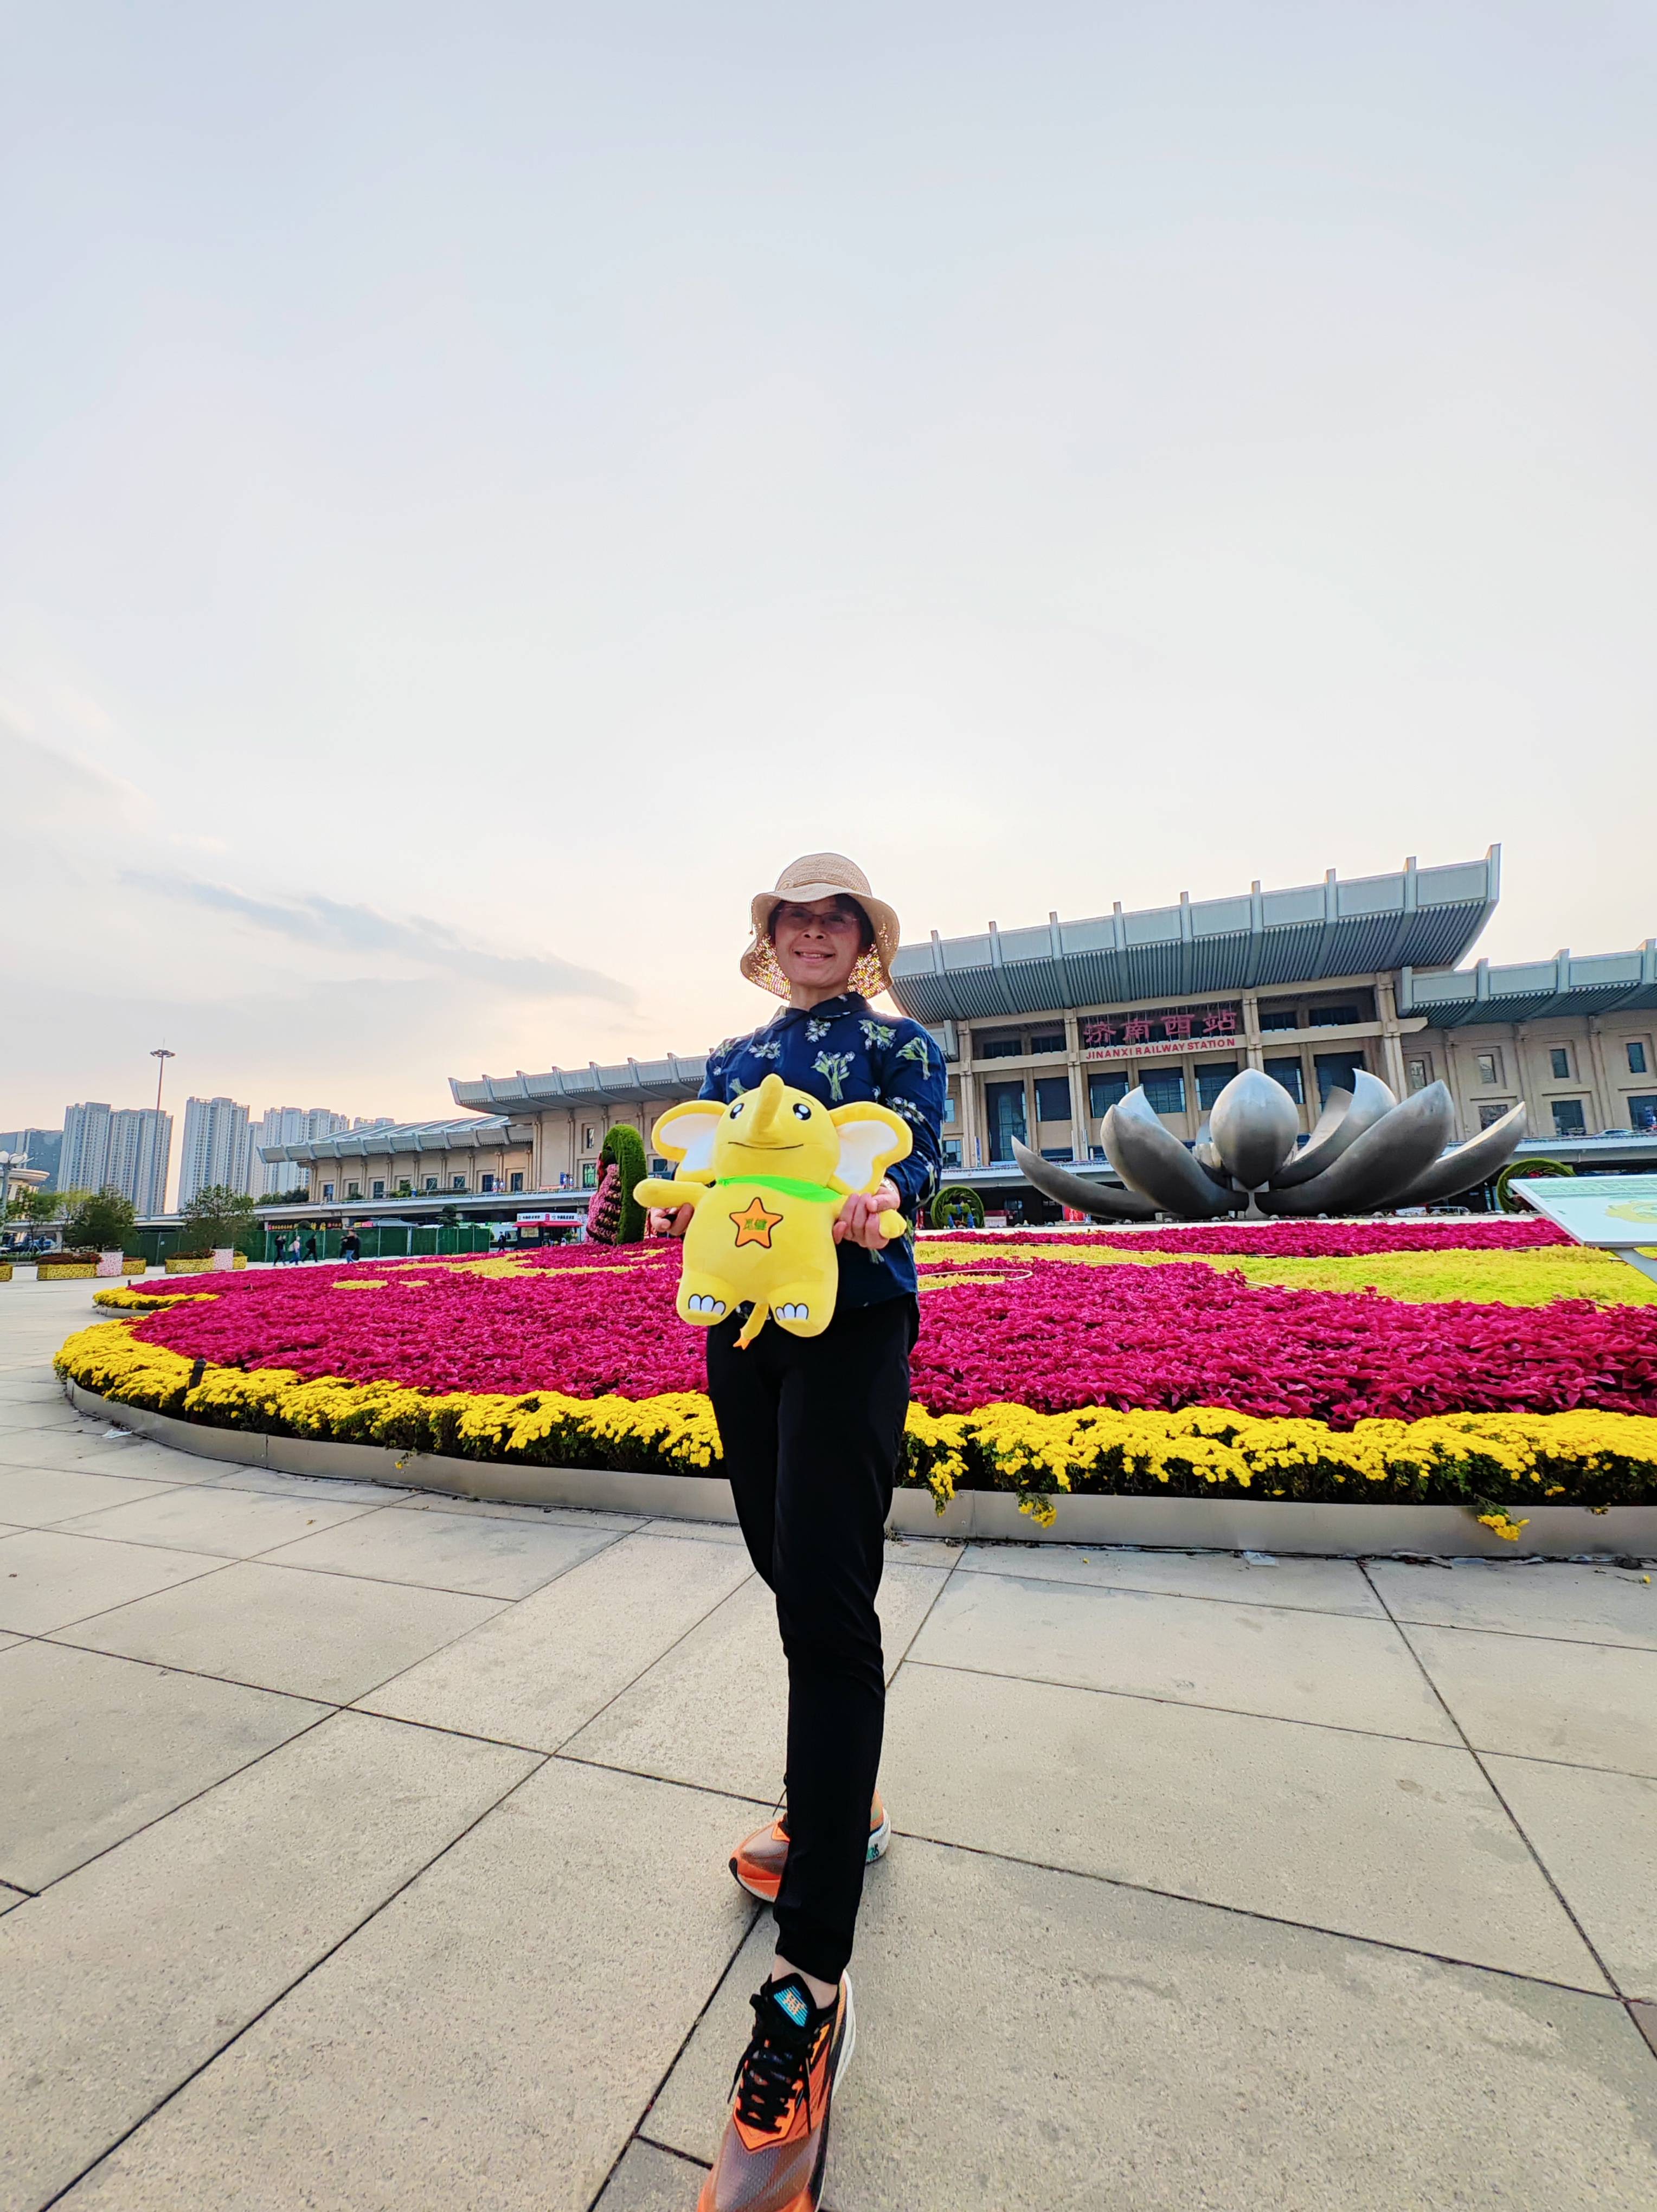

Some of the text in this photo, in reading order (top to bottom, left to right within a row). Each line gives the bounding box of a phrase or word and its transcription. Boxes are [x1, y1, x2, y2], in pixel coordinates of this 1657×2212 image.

[1083, 1009, 1237, 1043] 济南西站
[1086, 1038, 1235, 1059] JINANXI RAILWAY STATION
